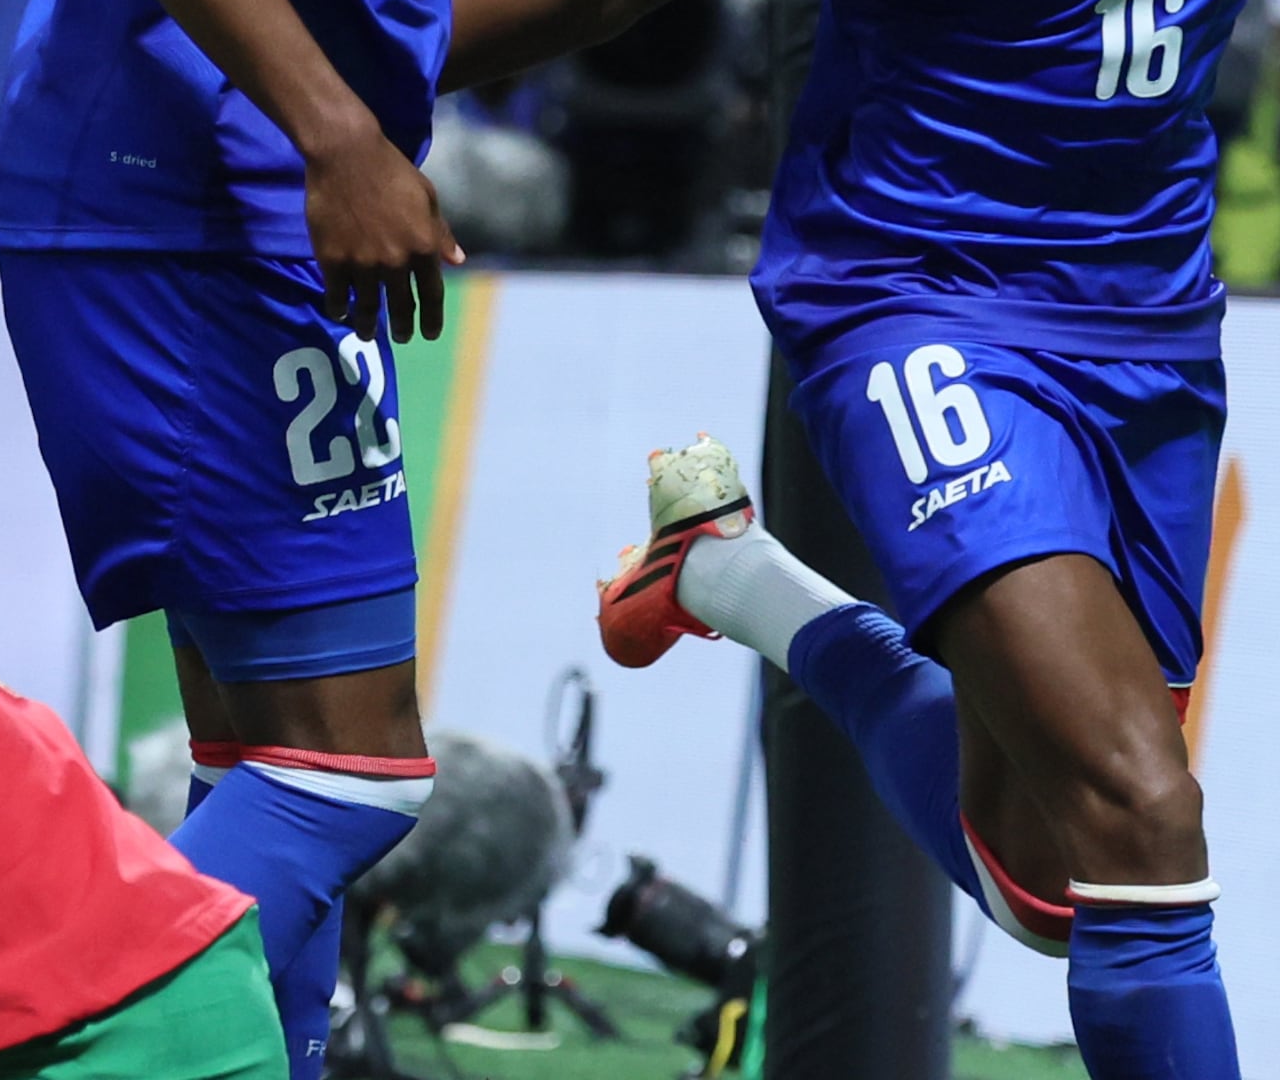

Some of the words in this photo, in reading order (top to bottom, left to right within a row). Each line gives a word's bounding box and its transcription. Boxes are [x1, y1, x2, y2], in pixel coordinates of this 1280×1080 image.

[273, 332, 402, 486] 22
[866, 344, 992, 485] 16
[302, 470, 408, 522] SAETA
[907, 460, 1013, 533] SAETA
